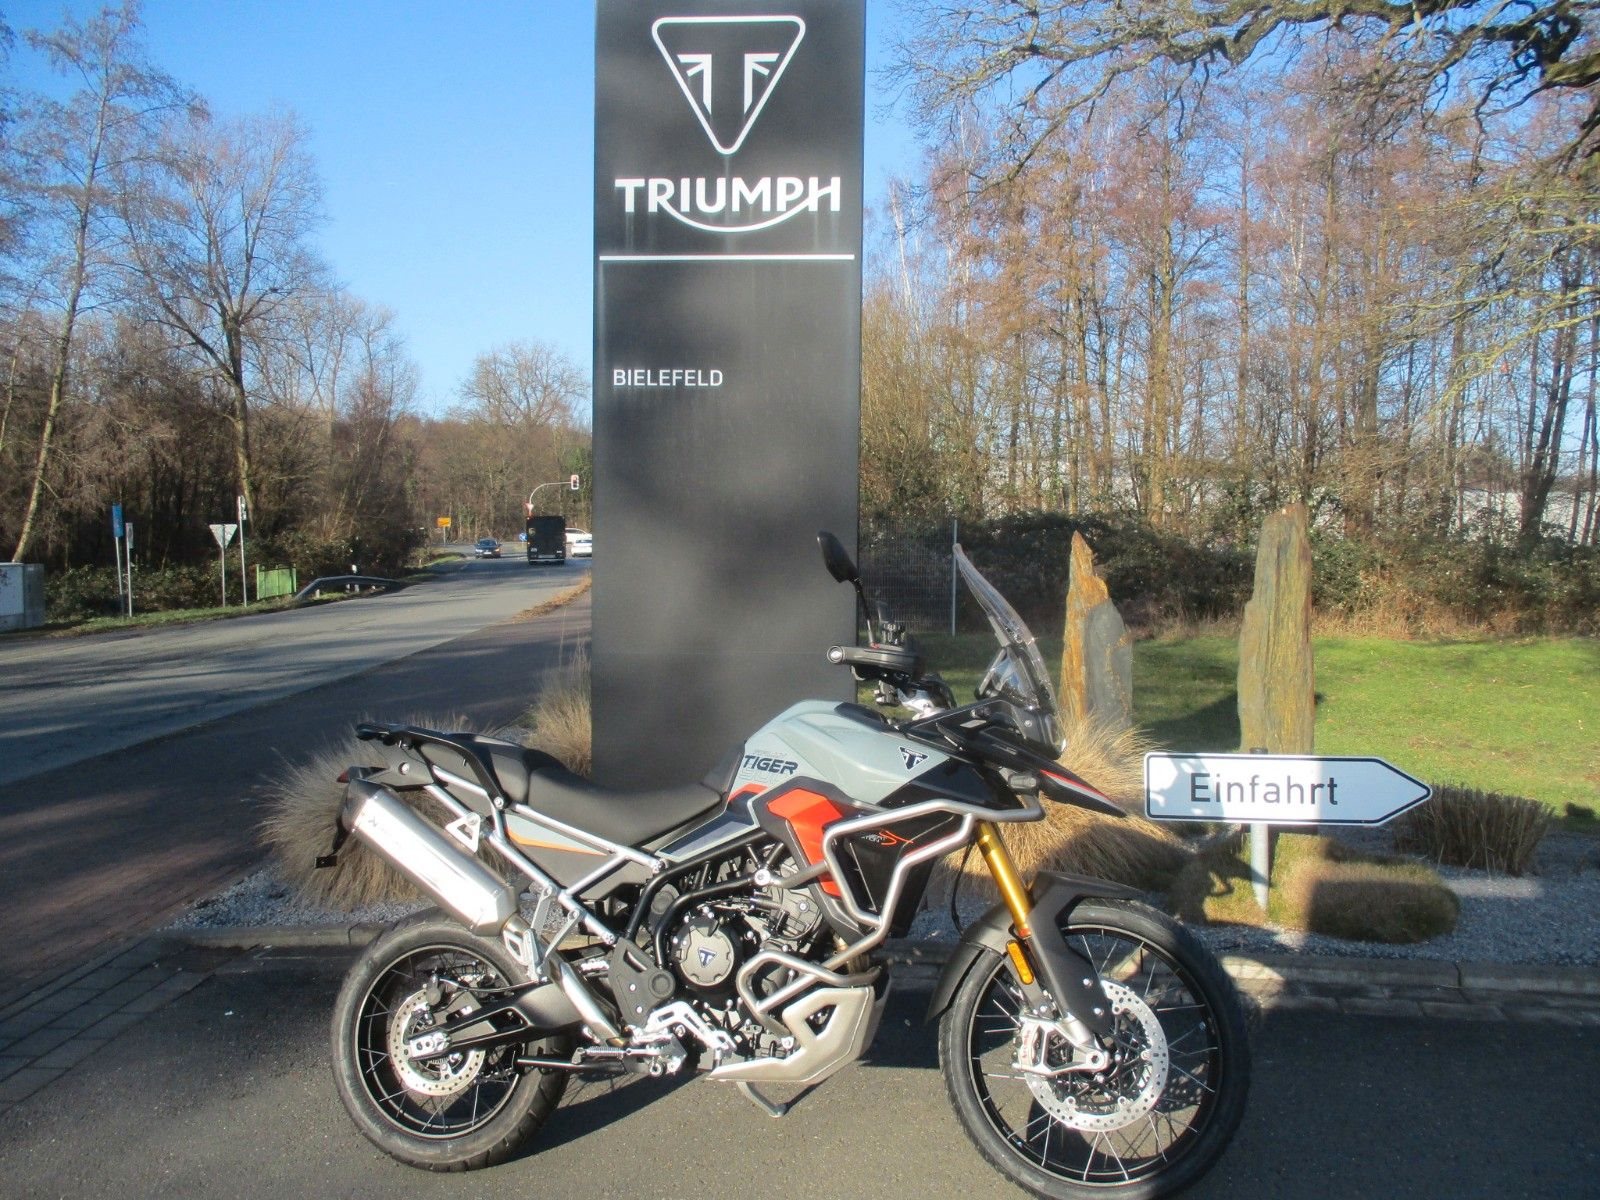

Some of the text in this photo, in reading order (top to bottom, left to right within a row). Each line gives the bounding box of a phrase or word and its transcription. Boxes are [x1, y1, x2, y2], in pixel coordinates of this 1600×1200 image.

[615, 177, 840, 232] TRIUMPH
[613, 369, 723, 386] BIELEFELD
[743, 755, 798, 775] TIGER
[1190, 772, 1338, 805] Einfahrt
